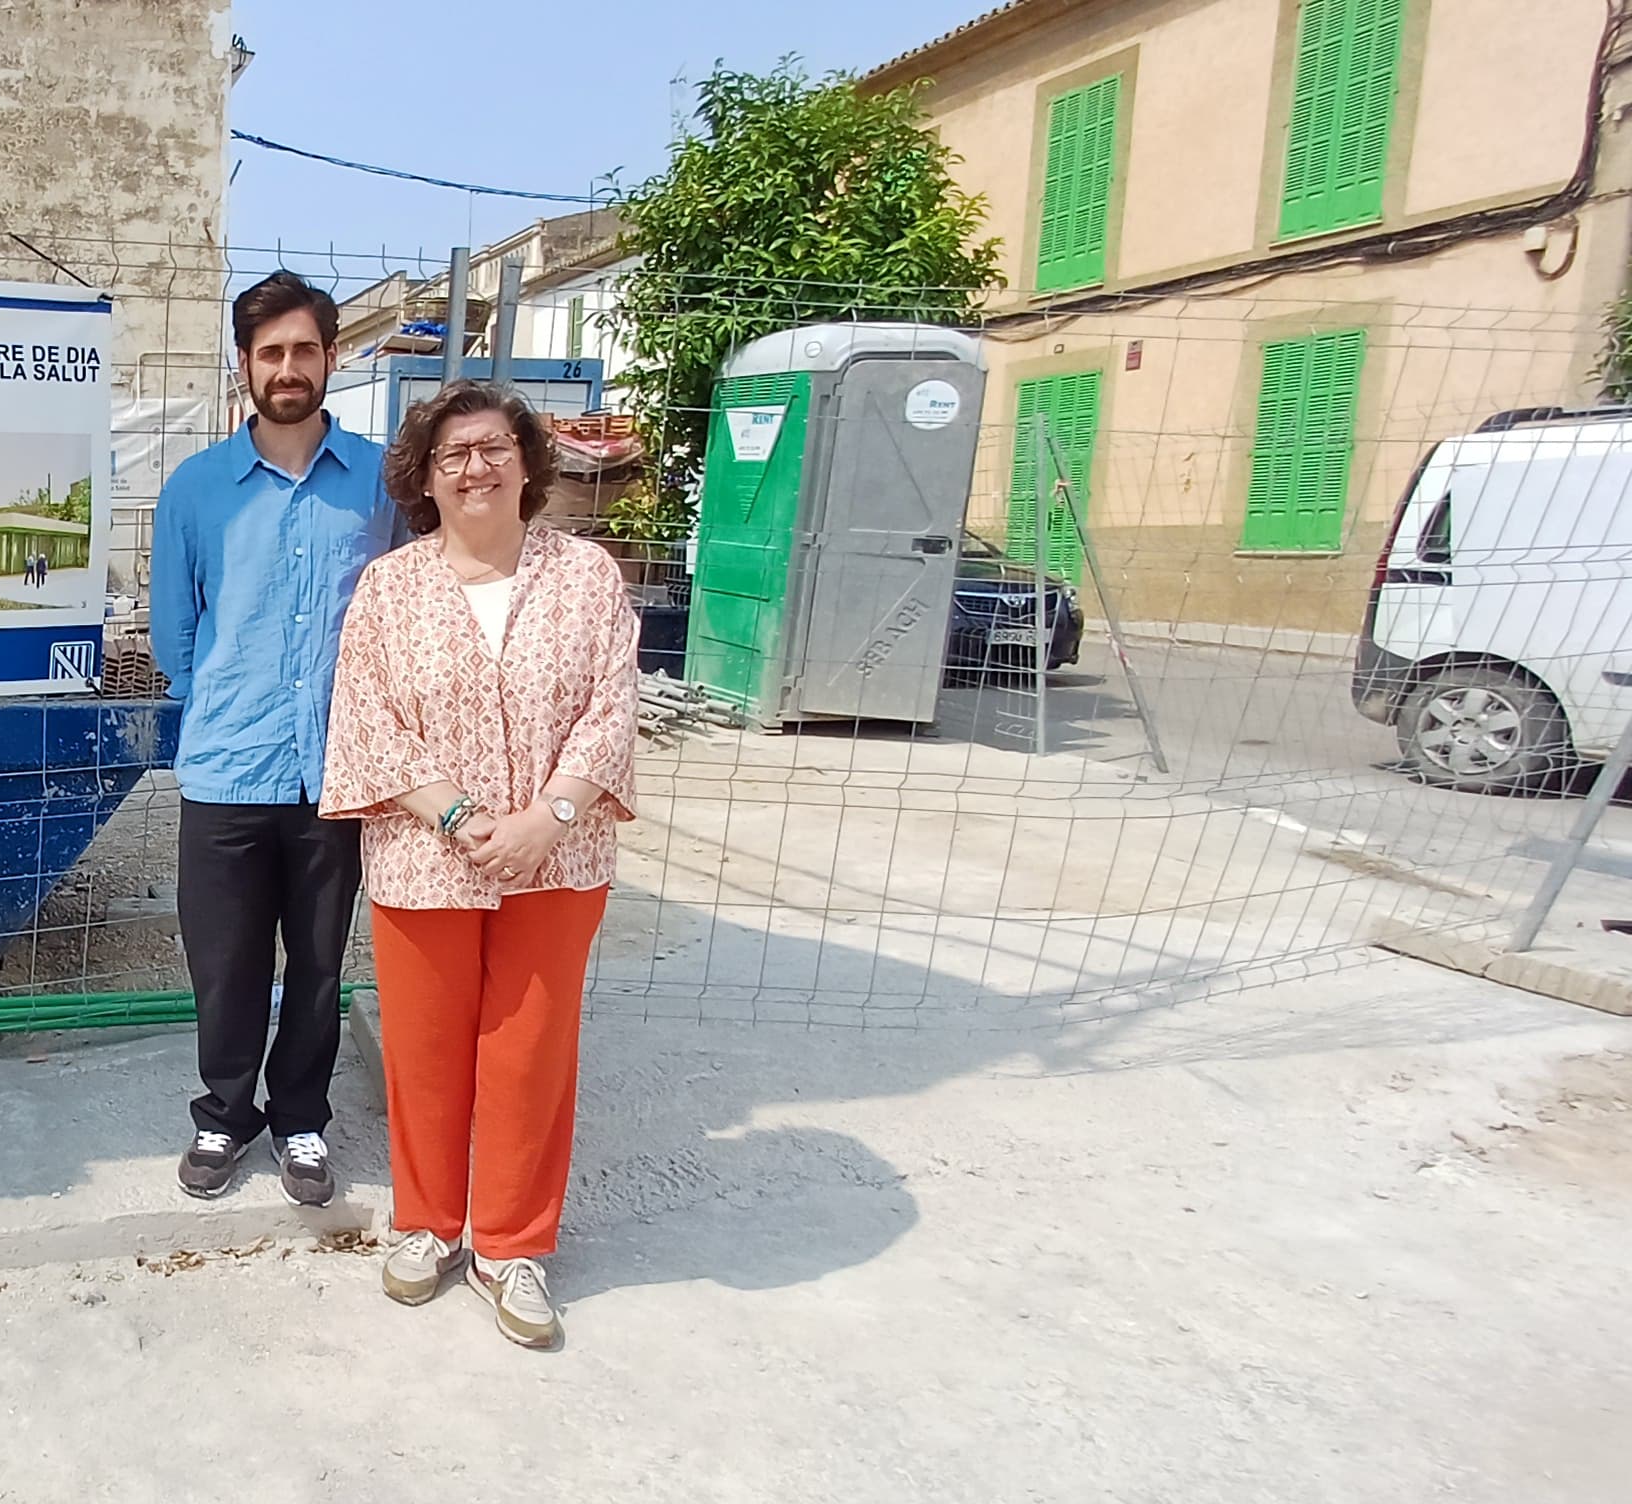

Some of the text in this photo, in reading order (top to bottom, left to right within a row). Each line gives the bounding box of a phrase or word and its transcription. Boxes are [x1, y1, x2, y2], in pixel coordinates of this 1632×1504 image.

[32, 345, 60, 363] DE
[66, 347, 101, 365] DIA
[0, 363, 27, 380] LA
[33, 364, 100, 382] SALUT
[563, 360, 582, 379] 26
